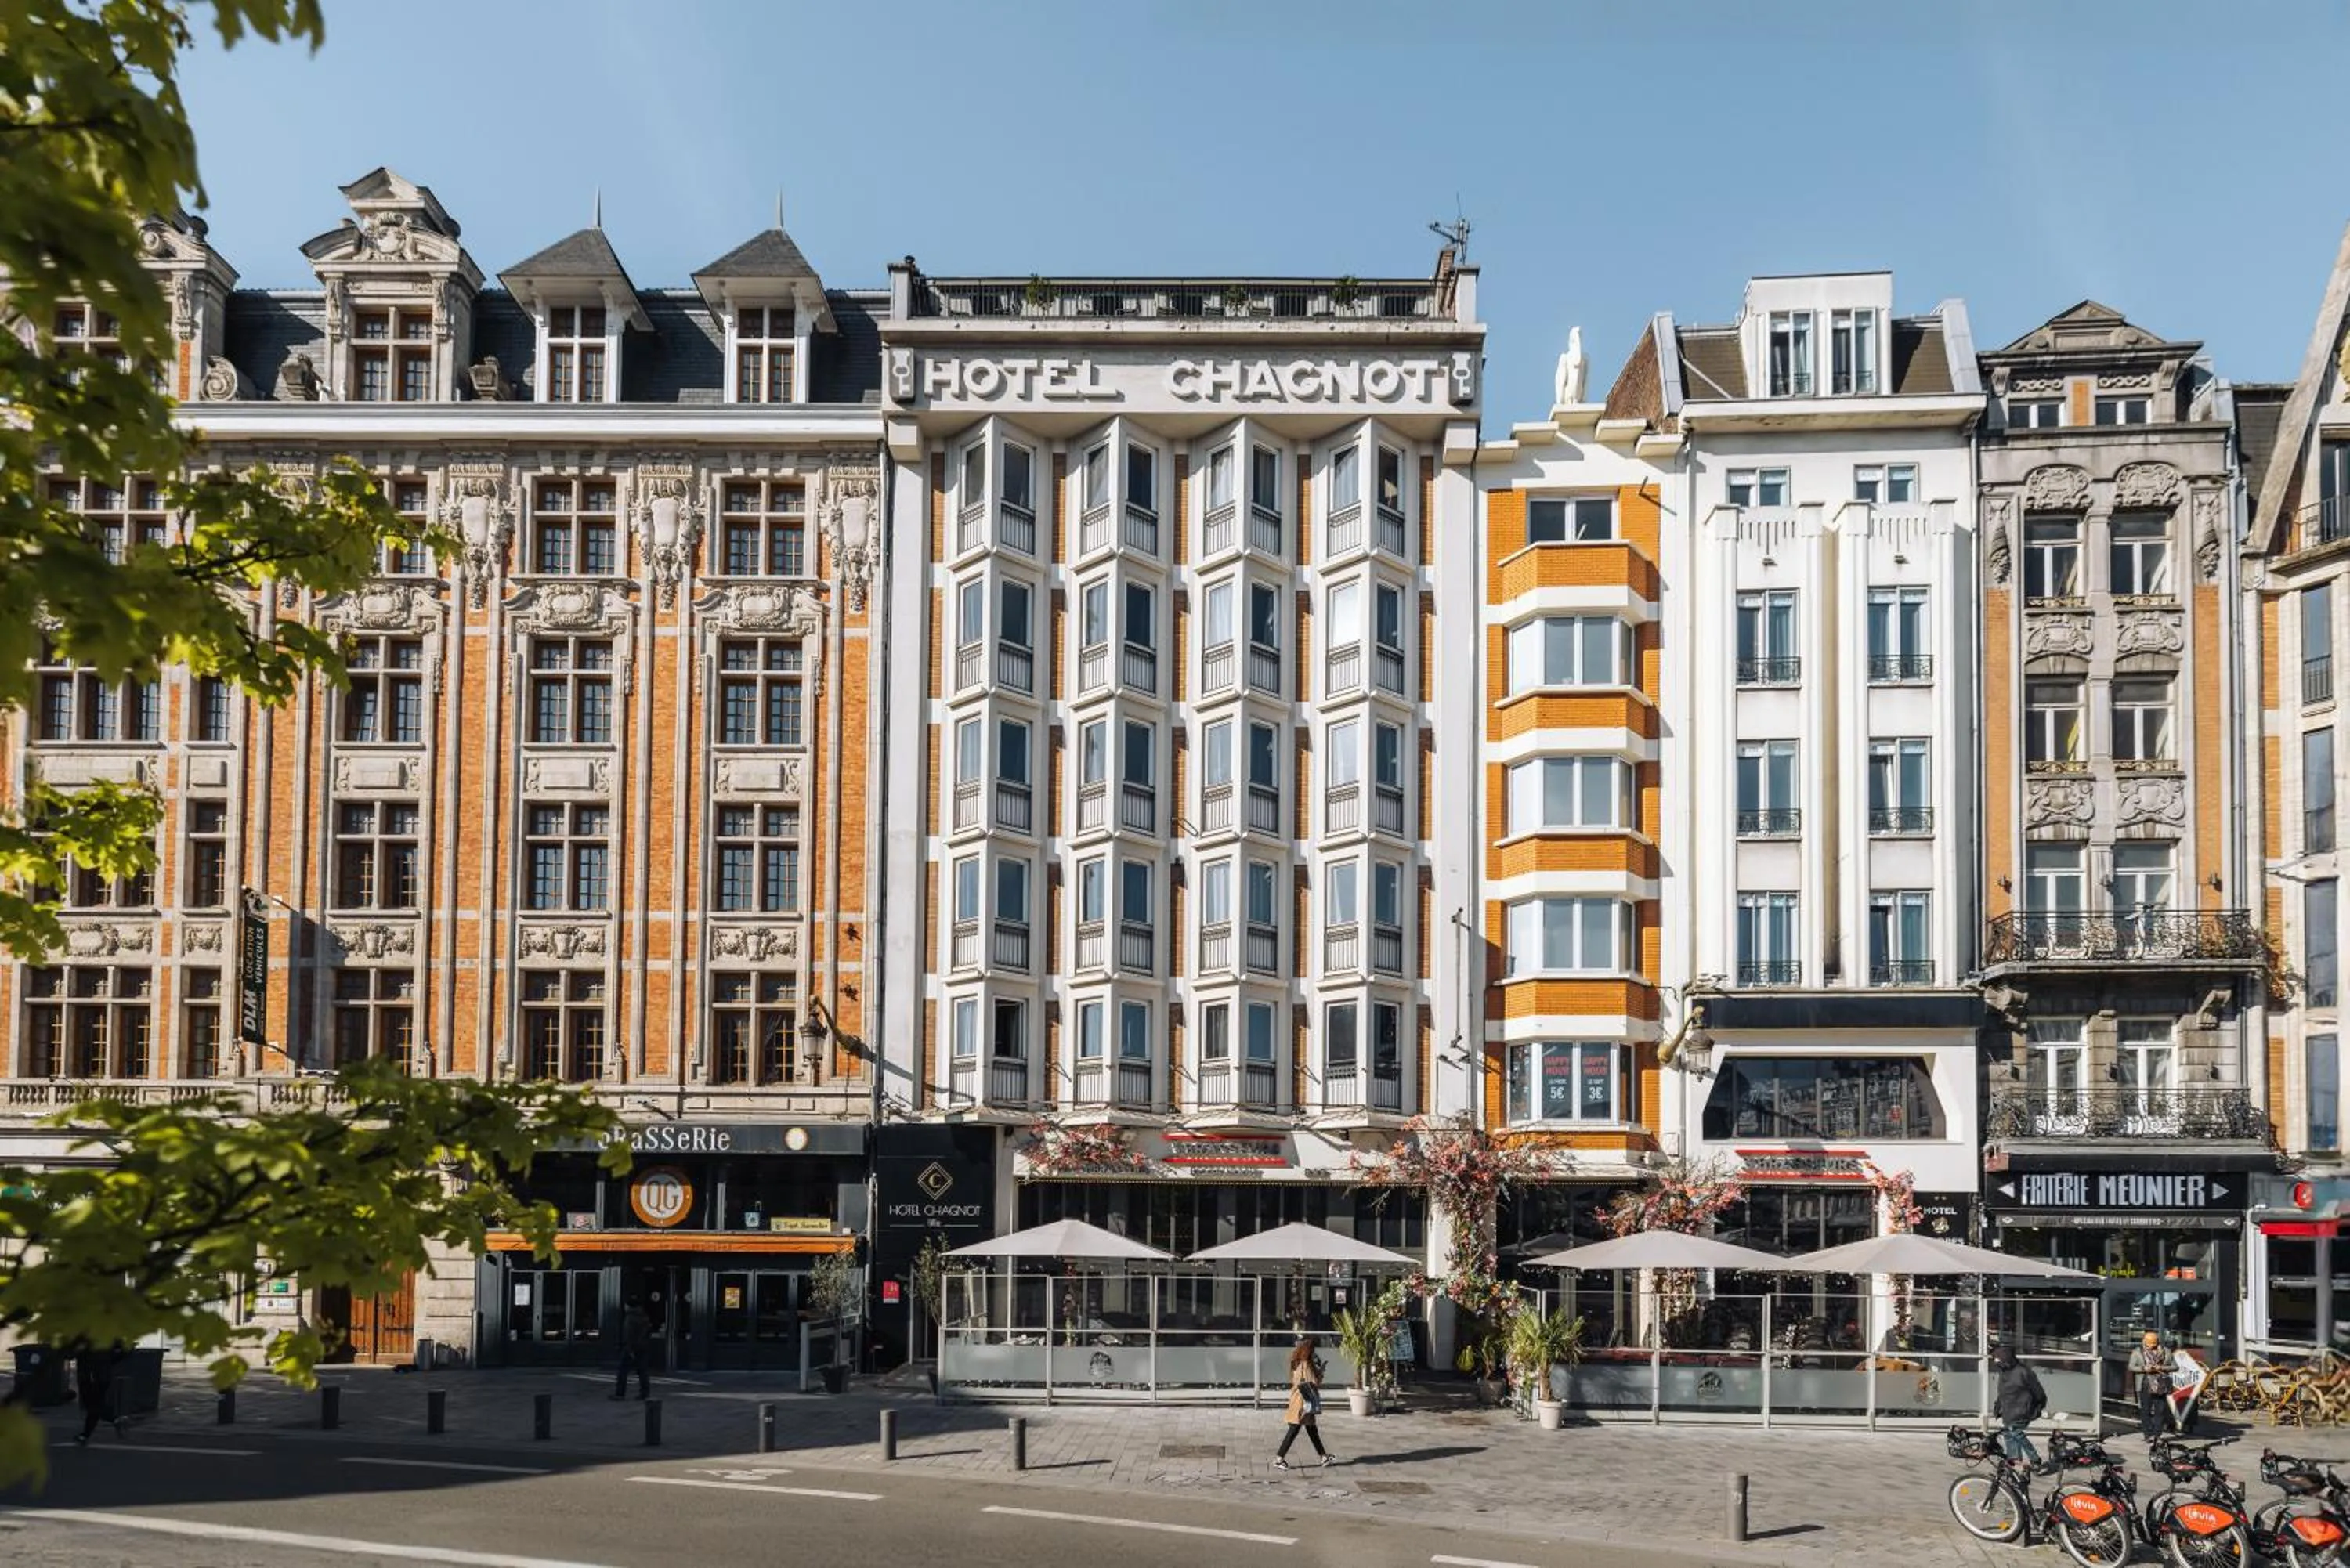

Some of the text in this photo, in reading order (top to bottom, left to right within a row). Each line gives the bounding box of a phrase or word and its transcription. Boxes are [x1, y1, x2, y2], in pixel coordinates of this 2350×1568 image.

[924, 358, 1447, 402] HOTEL CHAGNOT
[245, 927, 255, 979] LOCATION
[244, 989, 257, 1031] DLM
[1550, 1086, 1564, 1099] 5€
[1589, 1086, 1603, 1099] 3€
[646, 1180, 679, 1213] QG
[928, 1172, 942, 1189] C
[2021, 1173, 2206, 1206] FRITERIE MEUNIER
[888, 1204, 982, 1216] HOTEL CHAGNOT
